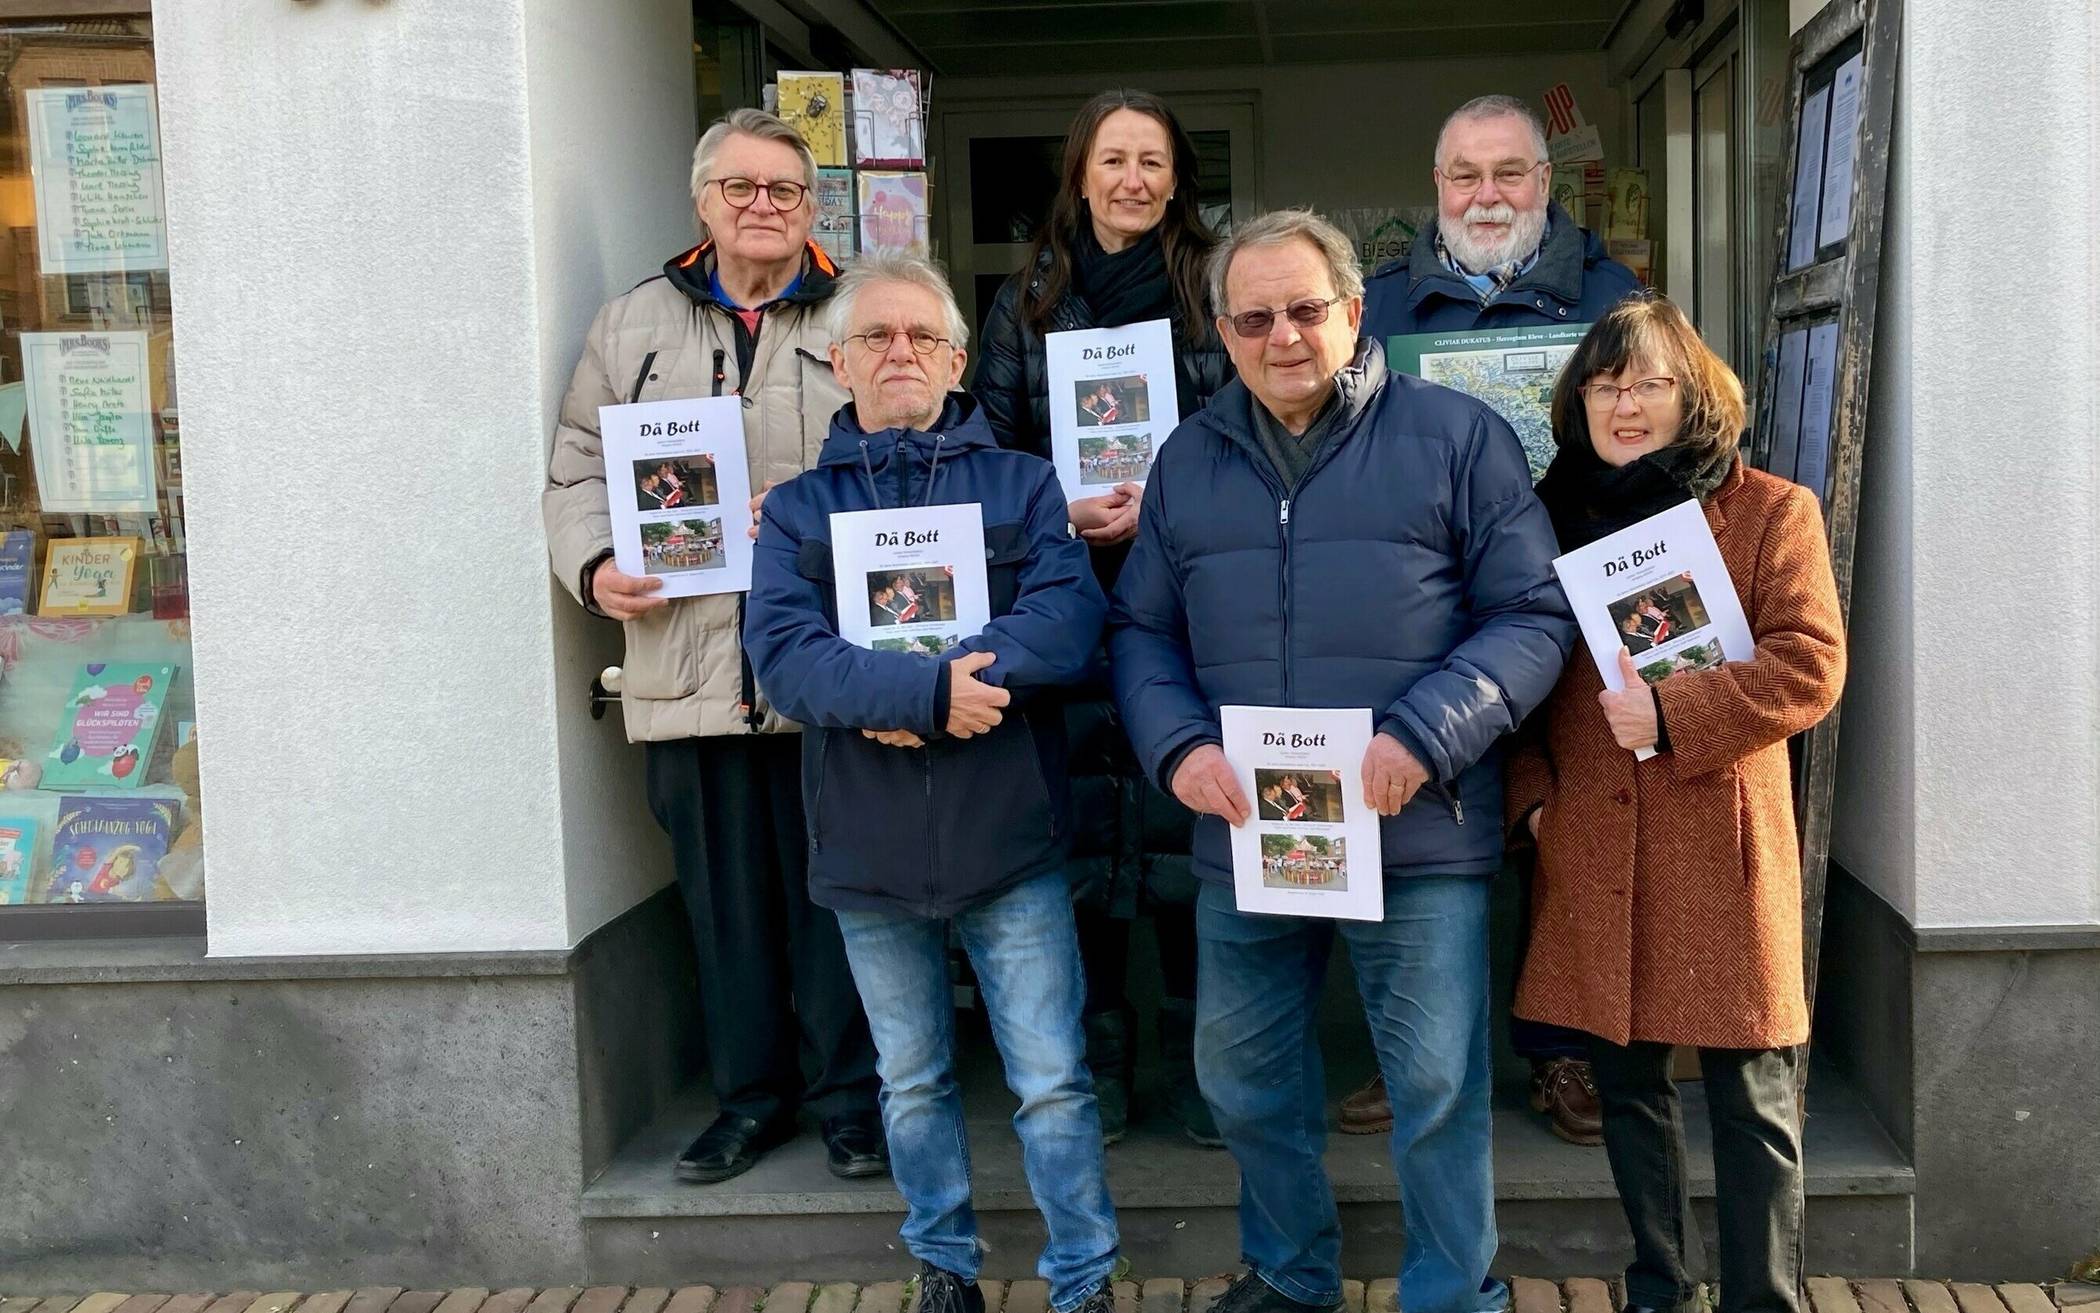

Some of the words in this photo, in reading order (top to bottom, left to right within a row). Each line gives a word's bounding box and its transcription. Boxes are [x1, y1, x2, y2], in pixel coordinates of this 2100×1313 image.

[1082, 347, 1103, 360] Dä
[1106, 344, 1135, 360] Bott
[639, 422, 662, 437] Dä
[667, 420, 701, 436] Bott
[875, 531, 899, 547] Dä
[904, 529, 939, 546] Bott
[62, 553, 111, 566] KINDER
[1602, 556, 1629, 577] Dä
[1631, 540, 1668, 568] Bott
[76, 718, 139, 727] GLÜCKSPILOTEN
[1262, 732, 1286, 747] Dä
[1290, 733, 1327, 748] Bott
